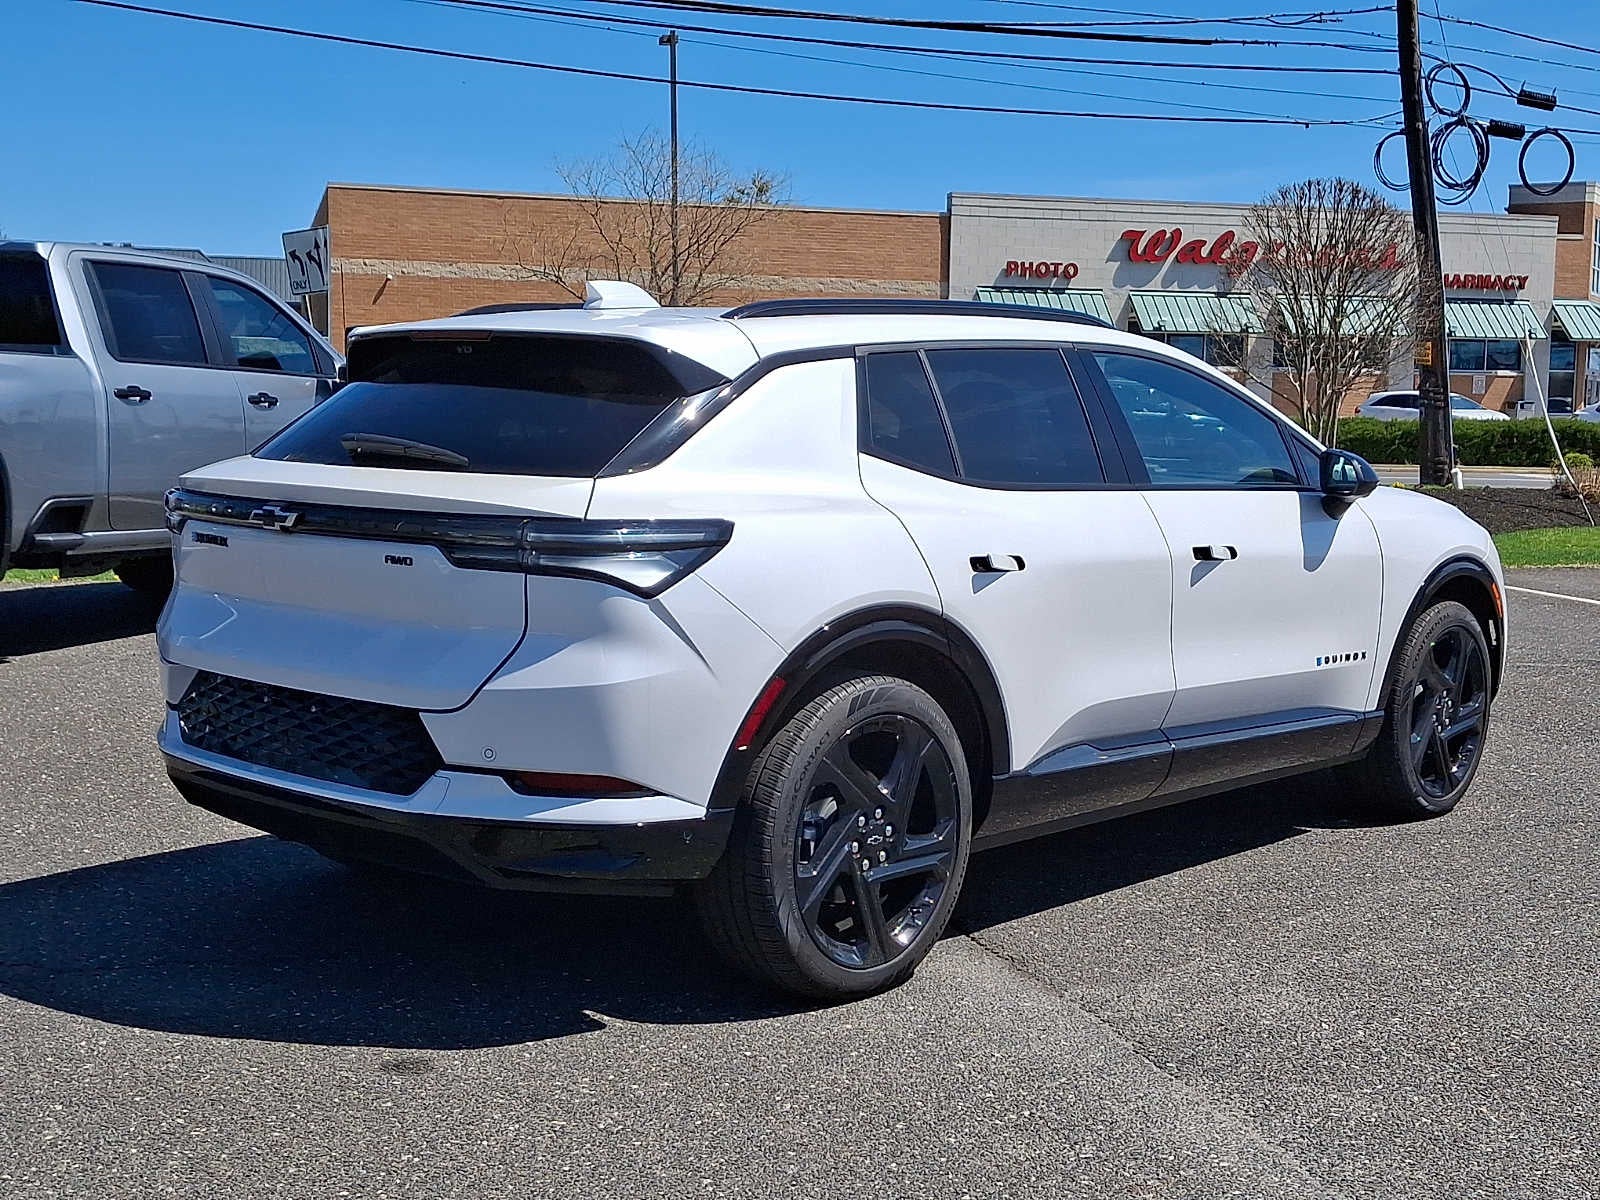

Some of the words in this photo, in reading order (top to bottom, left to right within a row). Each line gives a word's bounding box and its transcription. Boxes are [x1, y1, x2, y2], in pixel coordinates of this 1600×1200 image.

[1006, 261, 1079, 279] PHOTO
[292, 279, 307, 290] ONLY
[1443, 273, 1529, 290] ARMACY
[384, 554, 413, 566] AWD
[1316, 651, 1367, 667] EQUINOX
